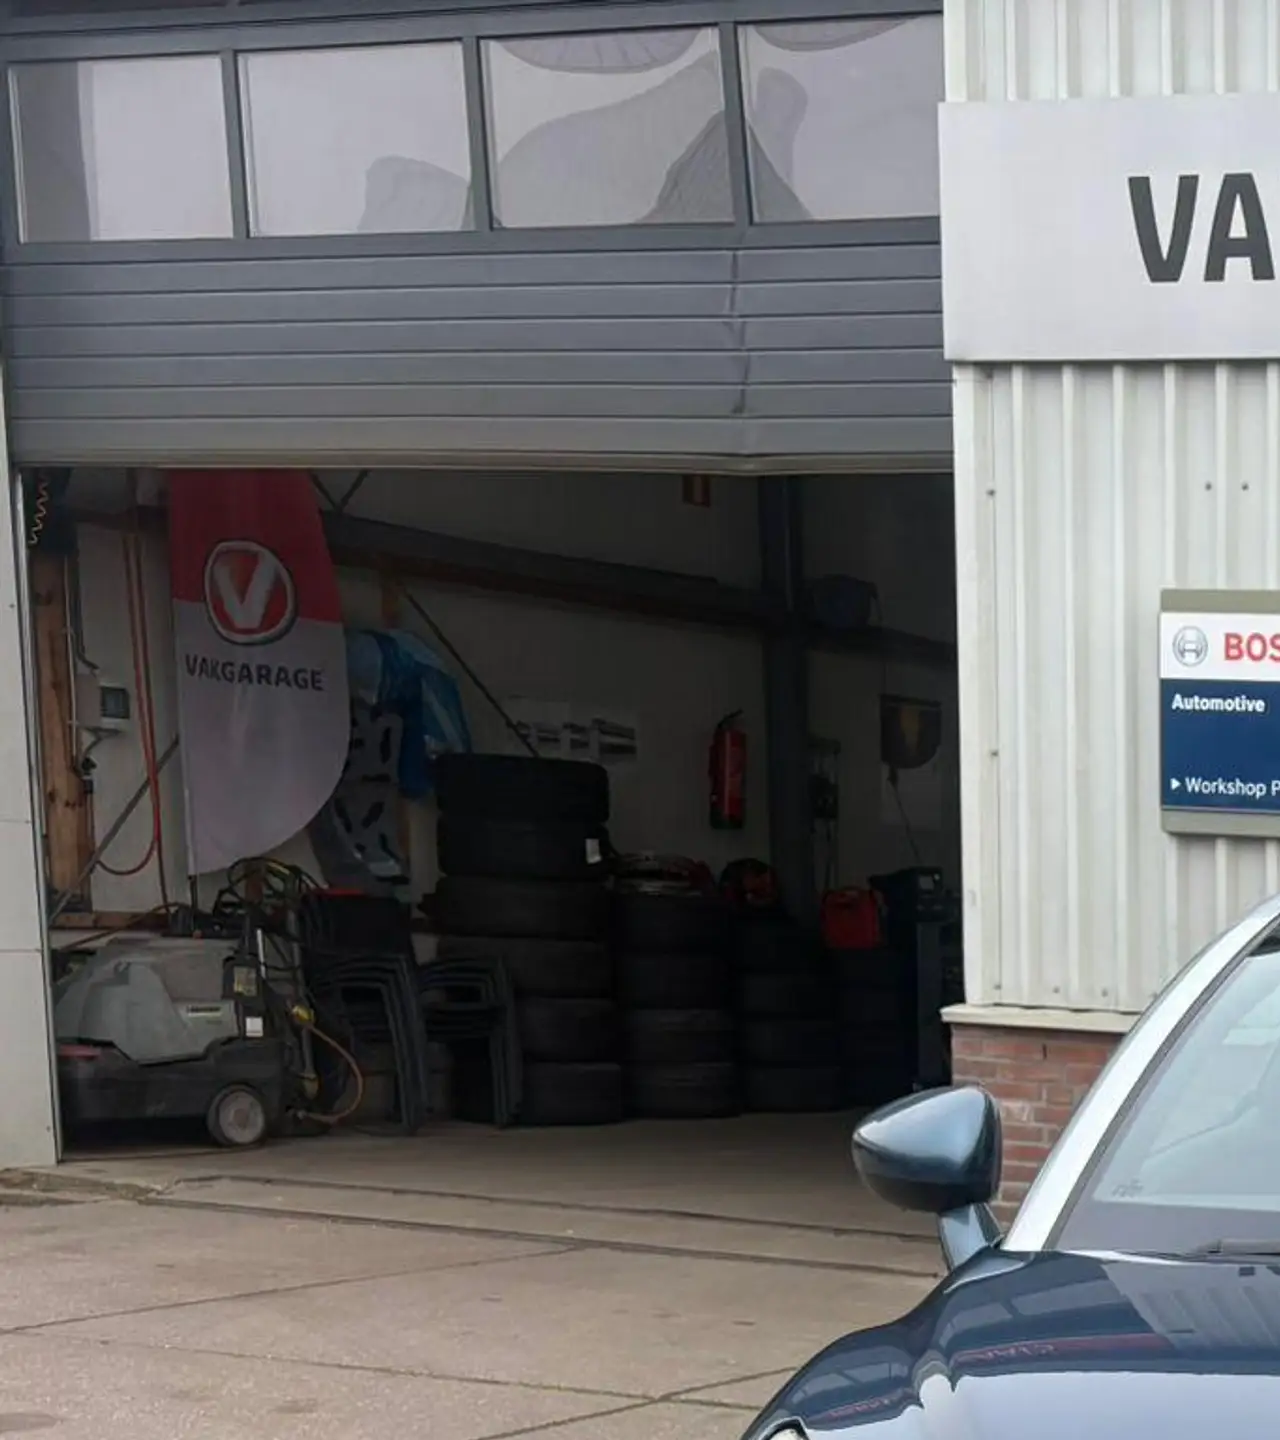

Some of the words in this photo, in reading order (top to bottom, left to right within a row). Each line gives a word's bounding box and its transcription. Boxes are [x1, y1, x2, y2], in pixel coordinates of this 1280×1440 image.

[185, 653, 325, 691] VAKGARAGE
[1171, 693, 1266, 713] Automotive
[1185, 777, 1267, 799] Workshop
